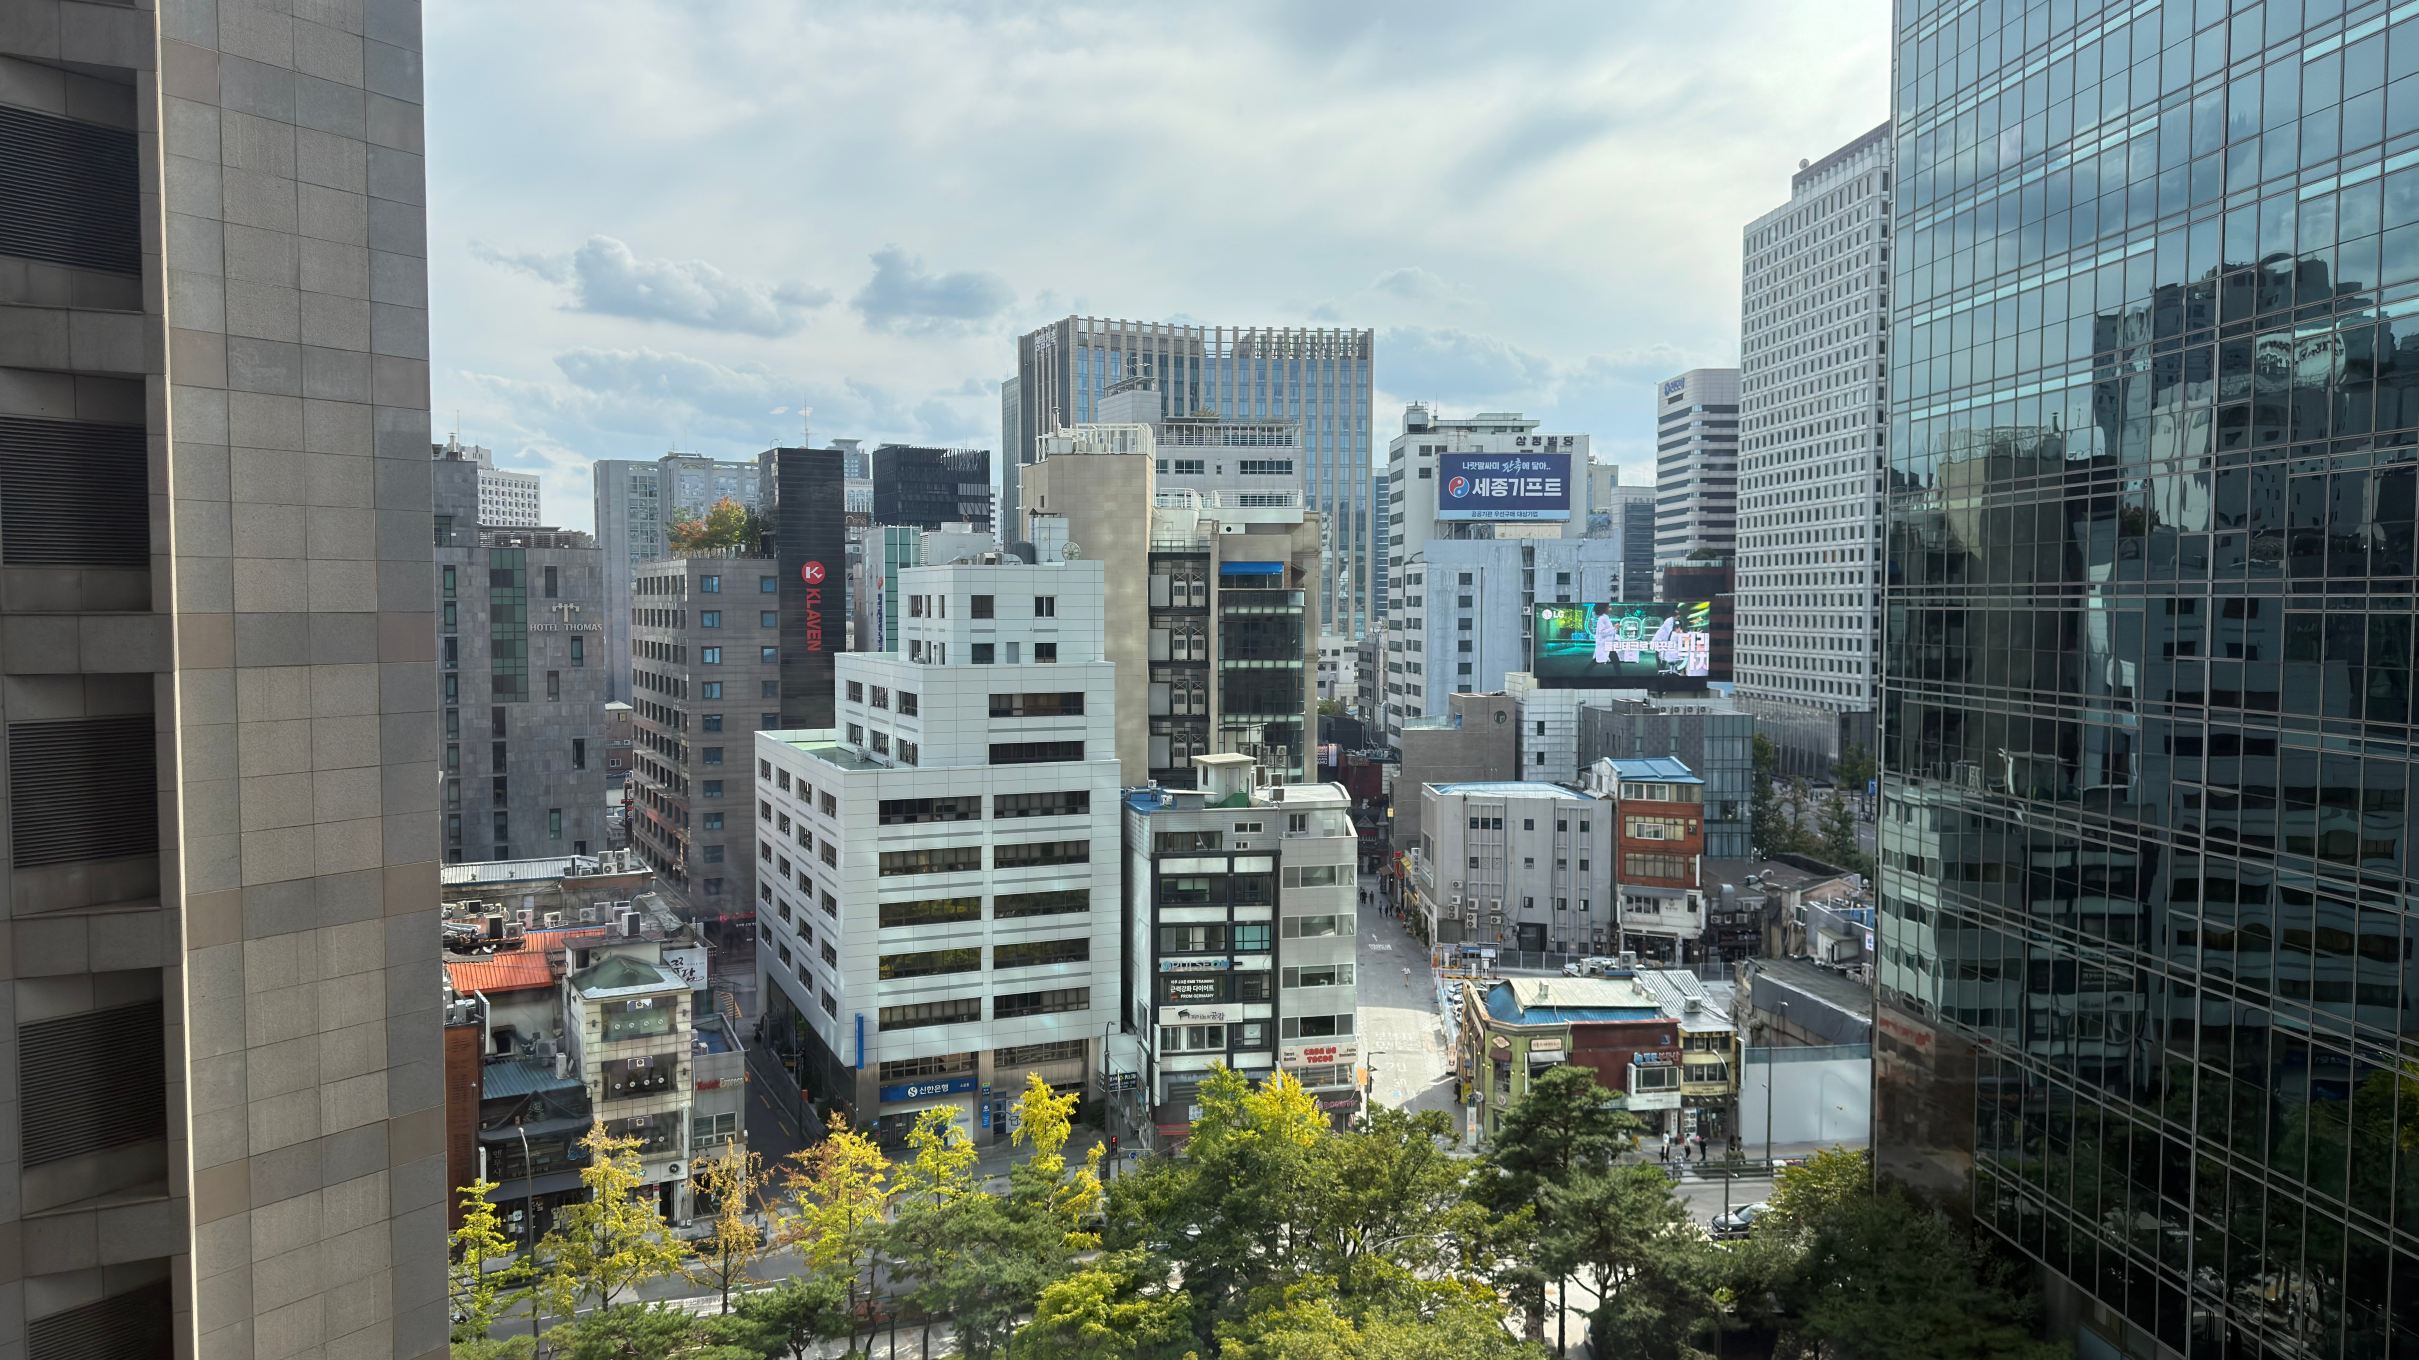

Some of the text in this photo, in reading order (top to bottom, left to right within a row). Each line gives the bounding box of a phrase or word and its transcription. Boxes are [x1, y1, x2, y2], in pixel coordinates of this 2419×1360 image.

[1462, 462, 1499, 470] 나랏말싸미
[1472, 478, 1562, 497] 세종기프트
[806, 588, 822, 651] KLAVEN
[1171, 985, 1192, 993] 근력강화
[1307, 1055, 1334, 1063] TACOS
[919, 1083, 949, 1095] 신한은행
